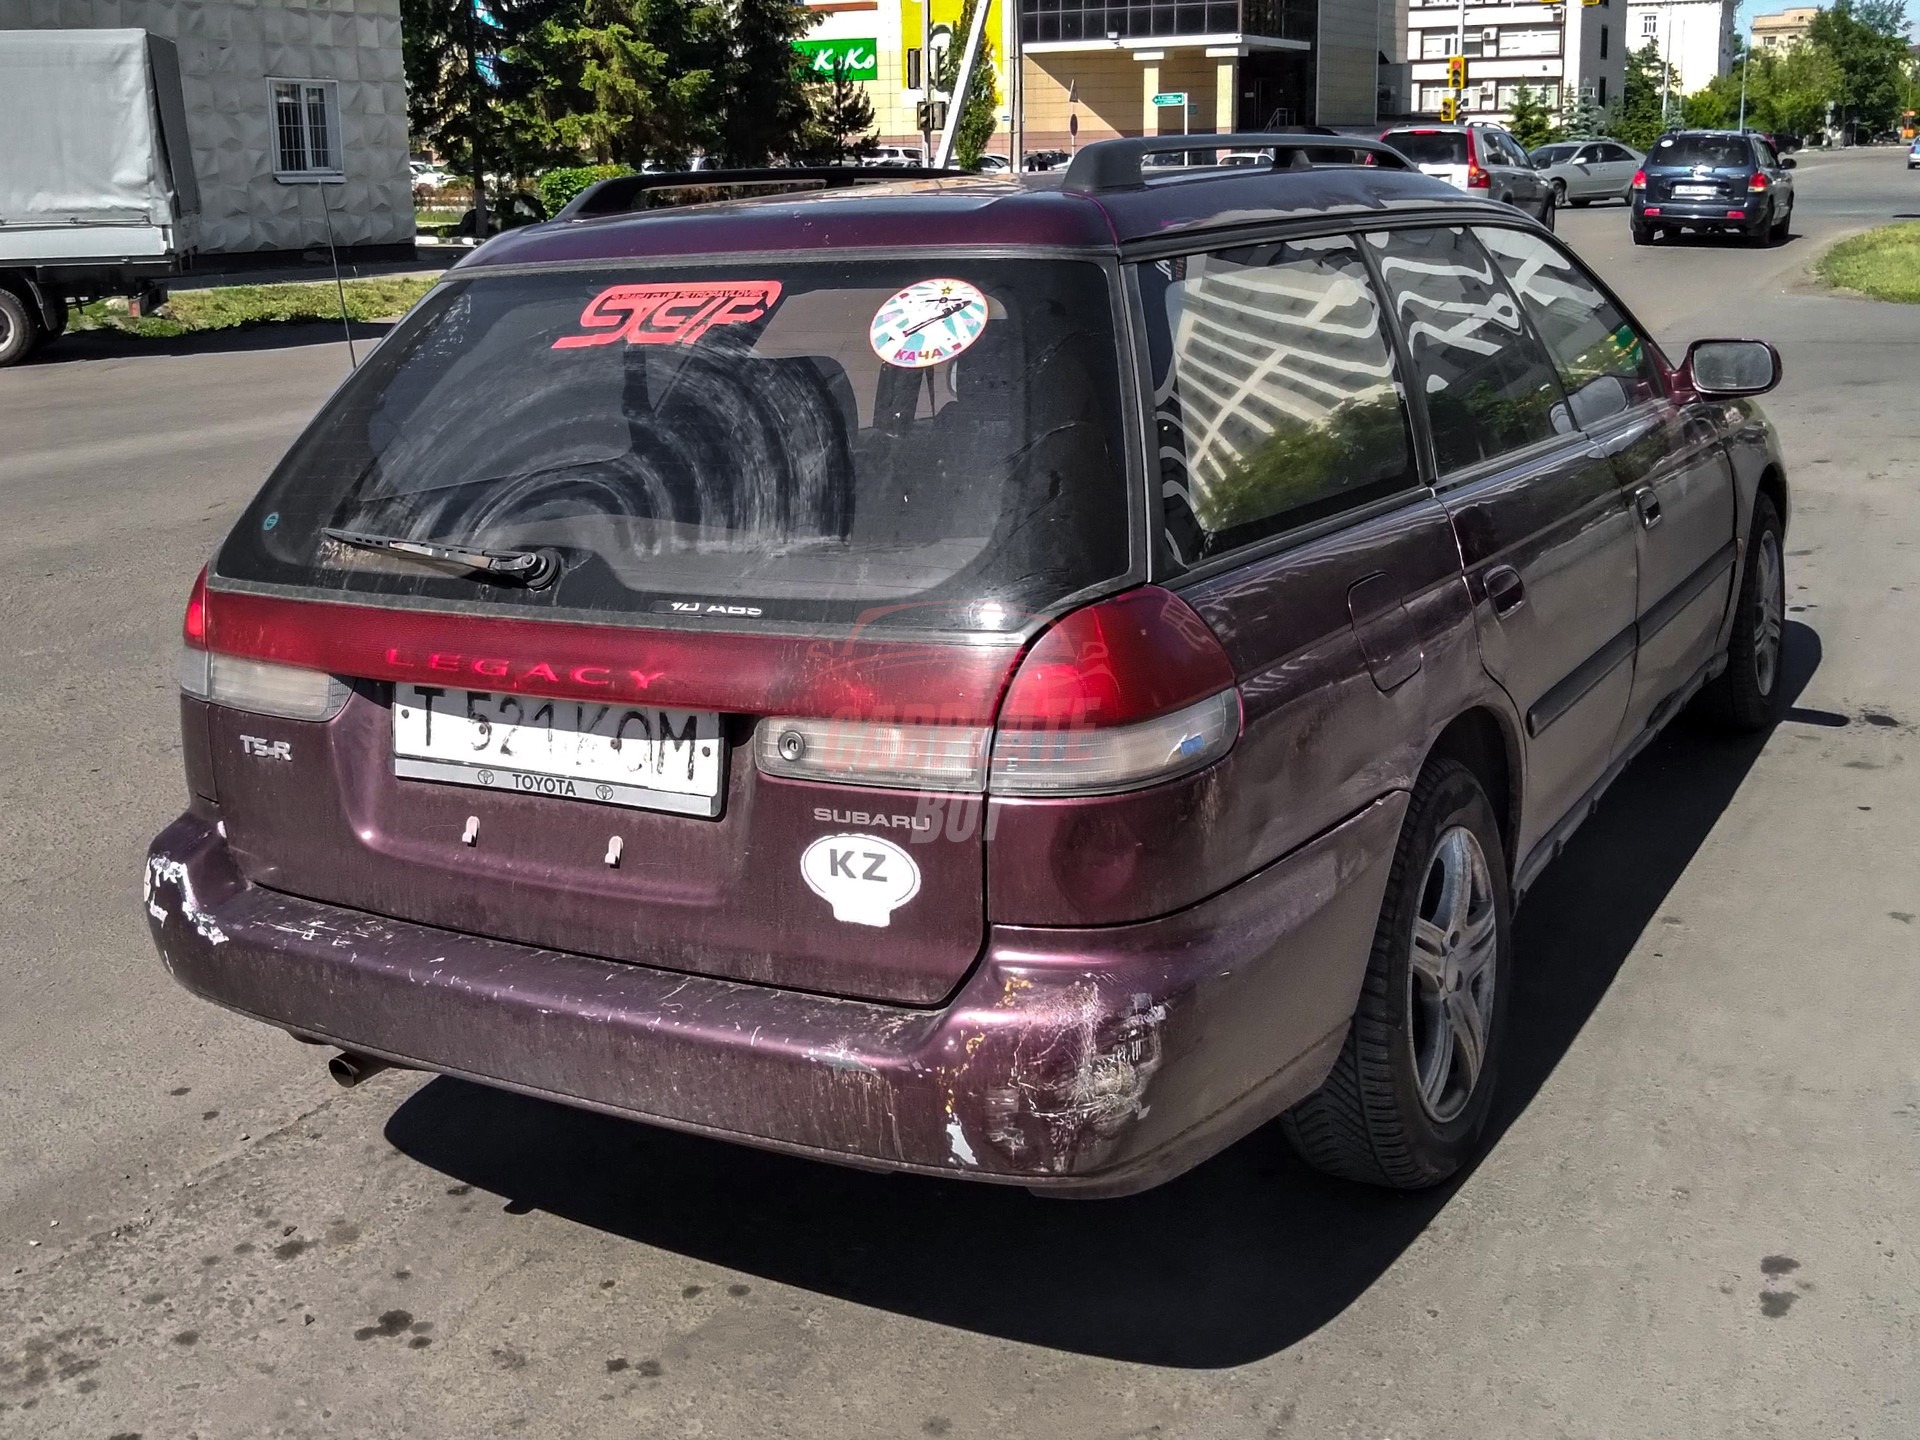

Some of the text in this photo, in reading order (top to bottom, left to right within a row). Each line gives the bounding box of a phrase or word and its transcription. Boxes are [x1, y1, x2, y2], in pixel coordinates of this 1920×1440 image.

[386, 648, 664, 690] LEGACY
[512, 773, 577, 796] TOYOTA
[813, 807, 931, 831] SUBARU
[829, 848, 888, 883] KZ
